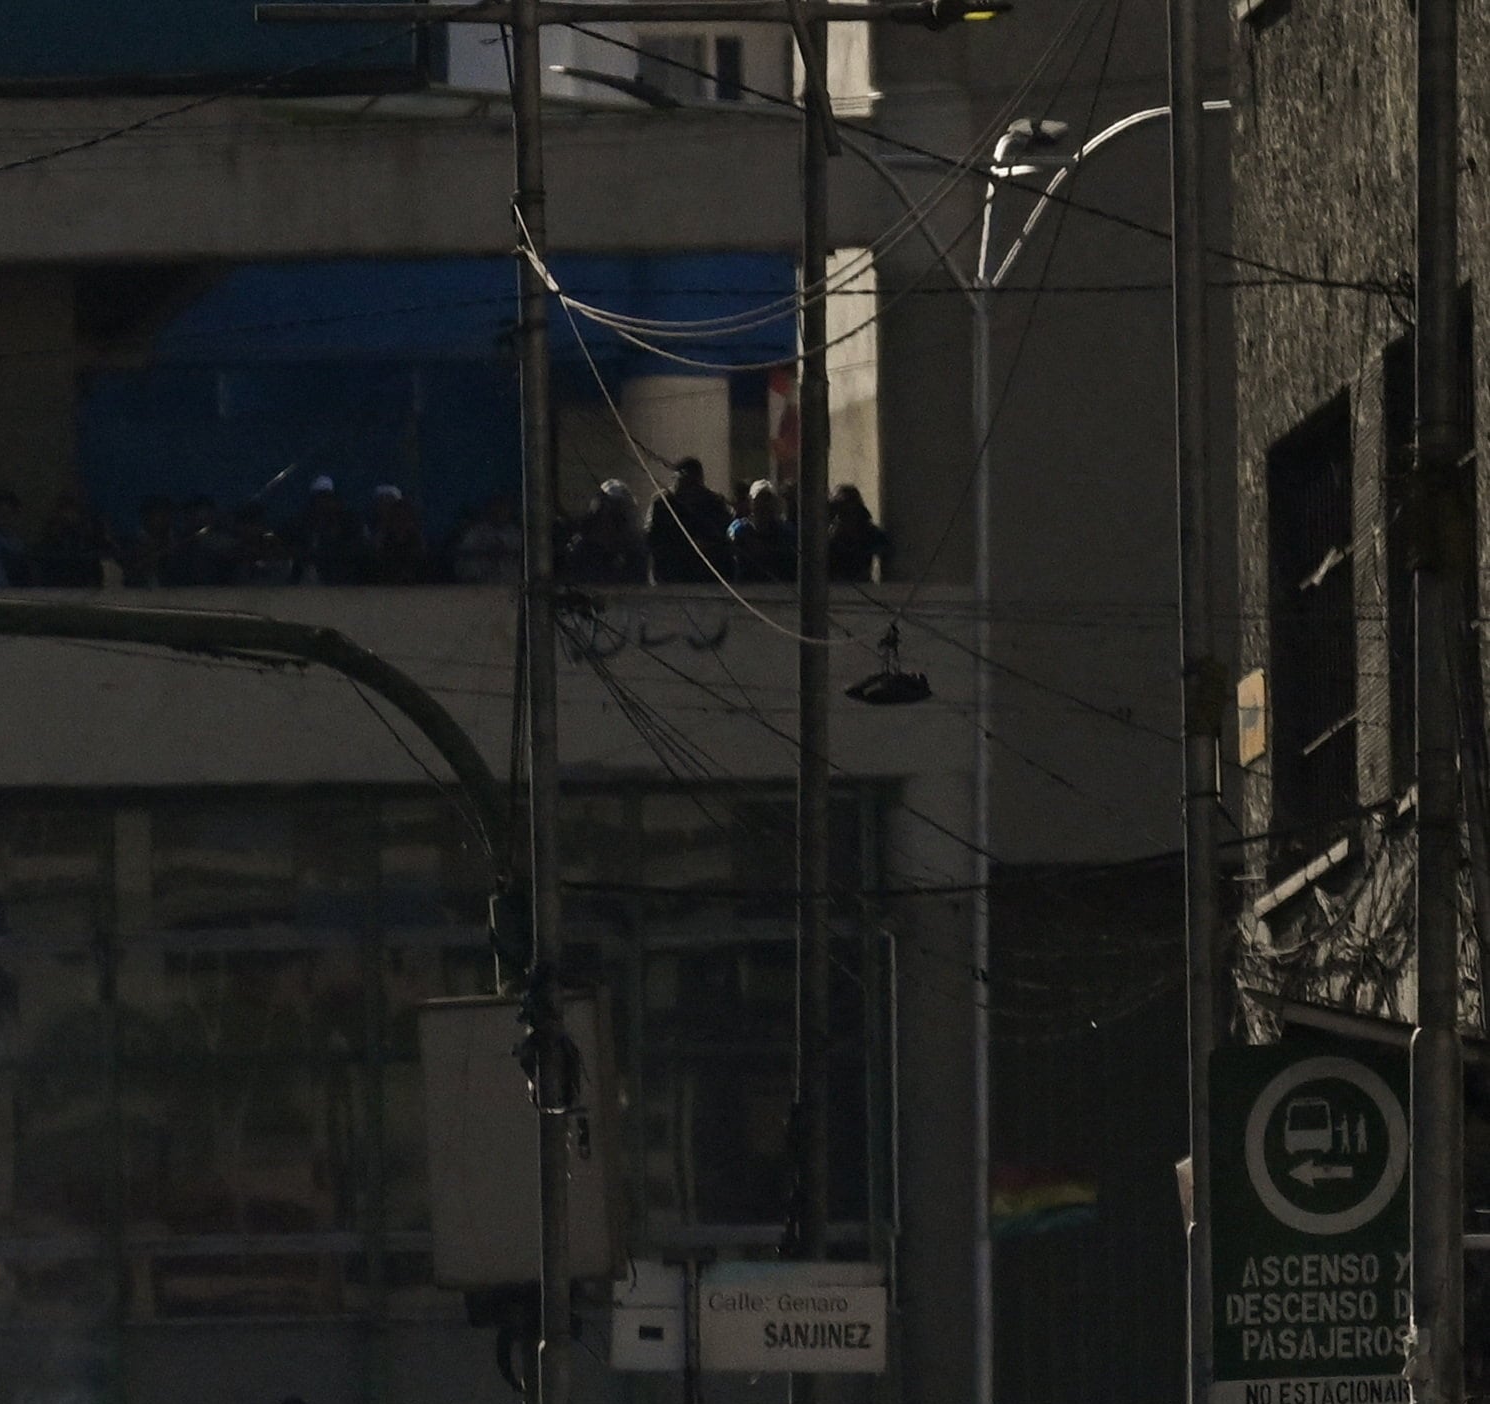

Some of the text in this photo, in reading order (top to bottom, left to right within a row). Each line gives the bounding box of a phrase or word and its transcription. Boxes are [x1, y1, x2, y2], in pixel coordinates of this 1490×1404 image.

[1242, 1252, 1380, 1288] ASCENSO
[777, 1292, 849, 1314] Genaro
[1225, 1287, 1412, 1325] DESCENSO D
[763, 1321, 872, 1349] SANJINEZ
[1241, 1324, 1411, 1361] PASAJEROS
